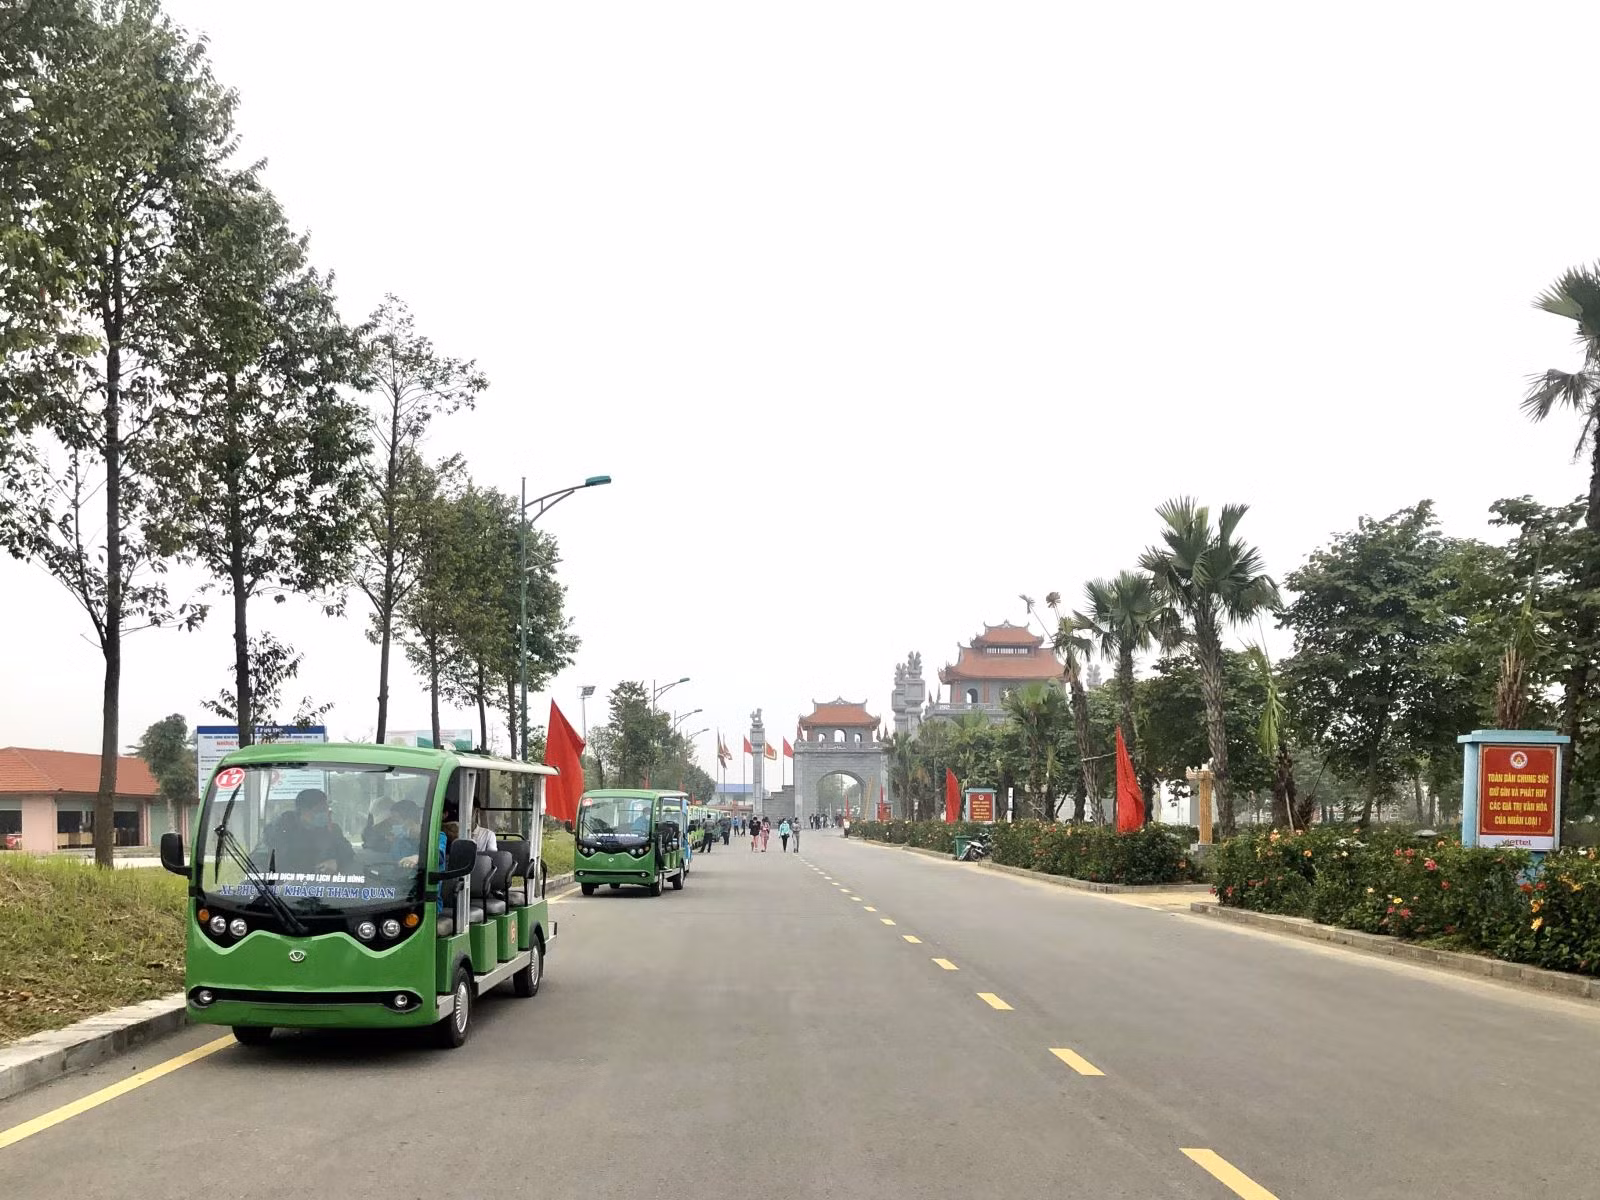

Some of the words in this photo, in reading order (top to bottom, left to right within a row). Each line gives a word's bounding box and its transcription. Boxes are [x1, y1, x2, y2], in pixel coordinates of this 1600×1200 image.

[220, 774, 241, 785] 17
[1488, 772, 1503, 783] TOÀN
[1517, 774, 1536, 783] CHUNG
[1537, 773, 1549, 784] SỨC
[1520, 787, 1535, 798] PHÁT
[1535, 788, 1547, 798] HUY
[1489, 800, 1501, 811] CÁC
[1494, 814, 1507, 825] CỦA
[265, 871, 279, 880] TÂM
[280, 873, 296, 882] DỊCH
[316, 874, 331, 883] LỊCH
[284, 881, 325, 897] KHÁCH
[326, 886, 360, 899] THAM
[361, 887, 396, 901] QUAN
